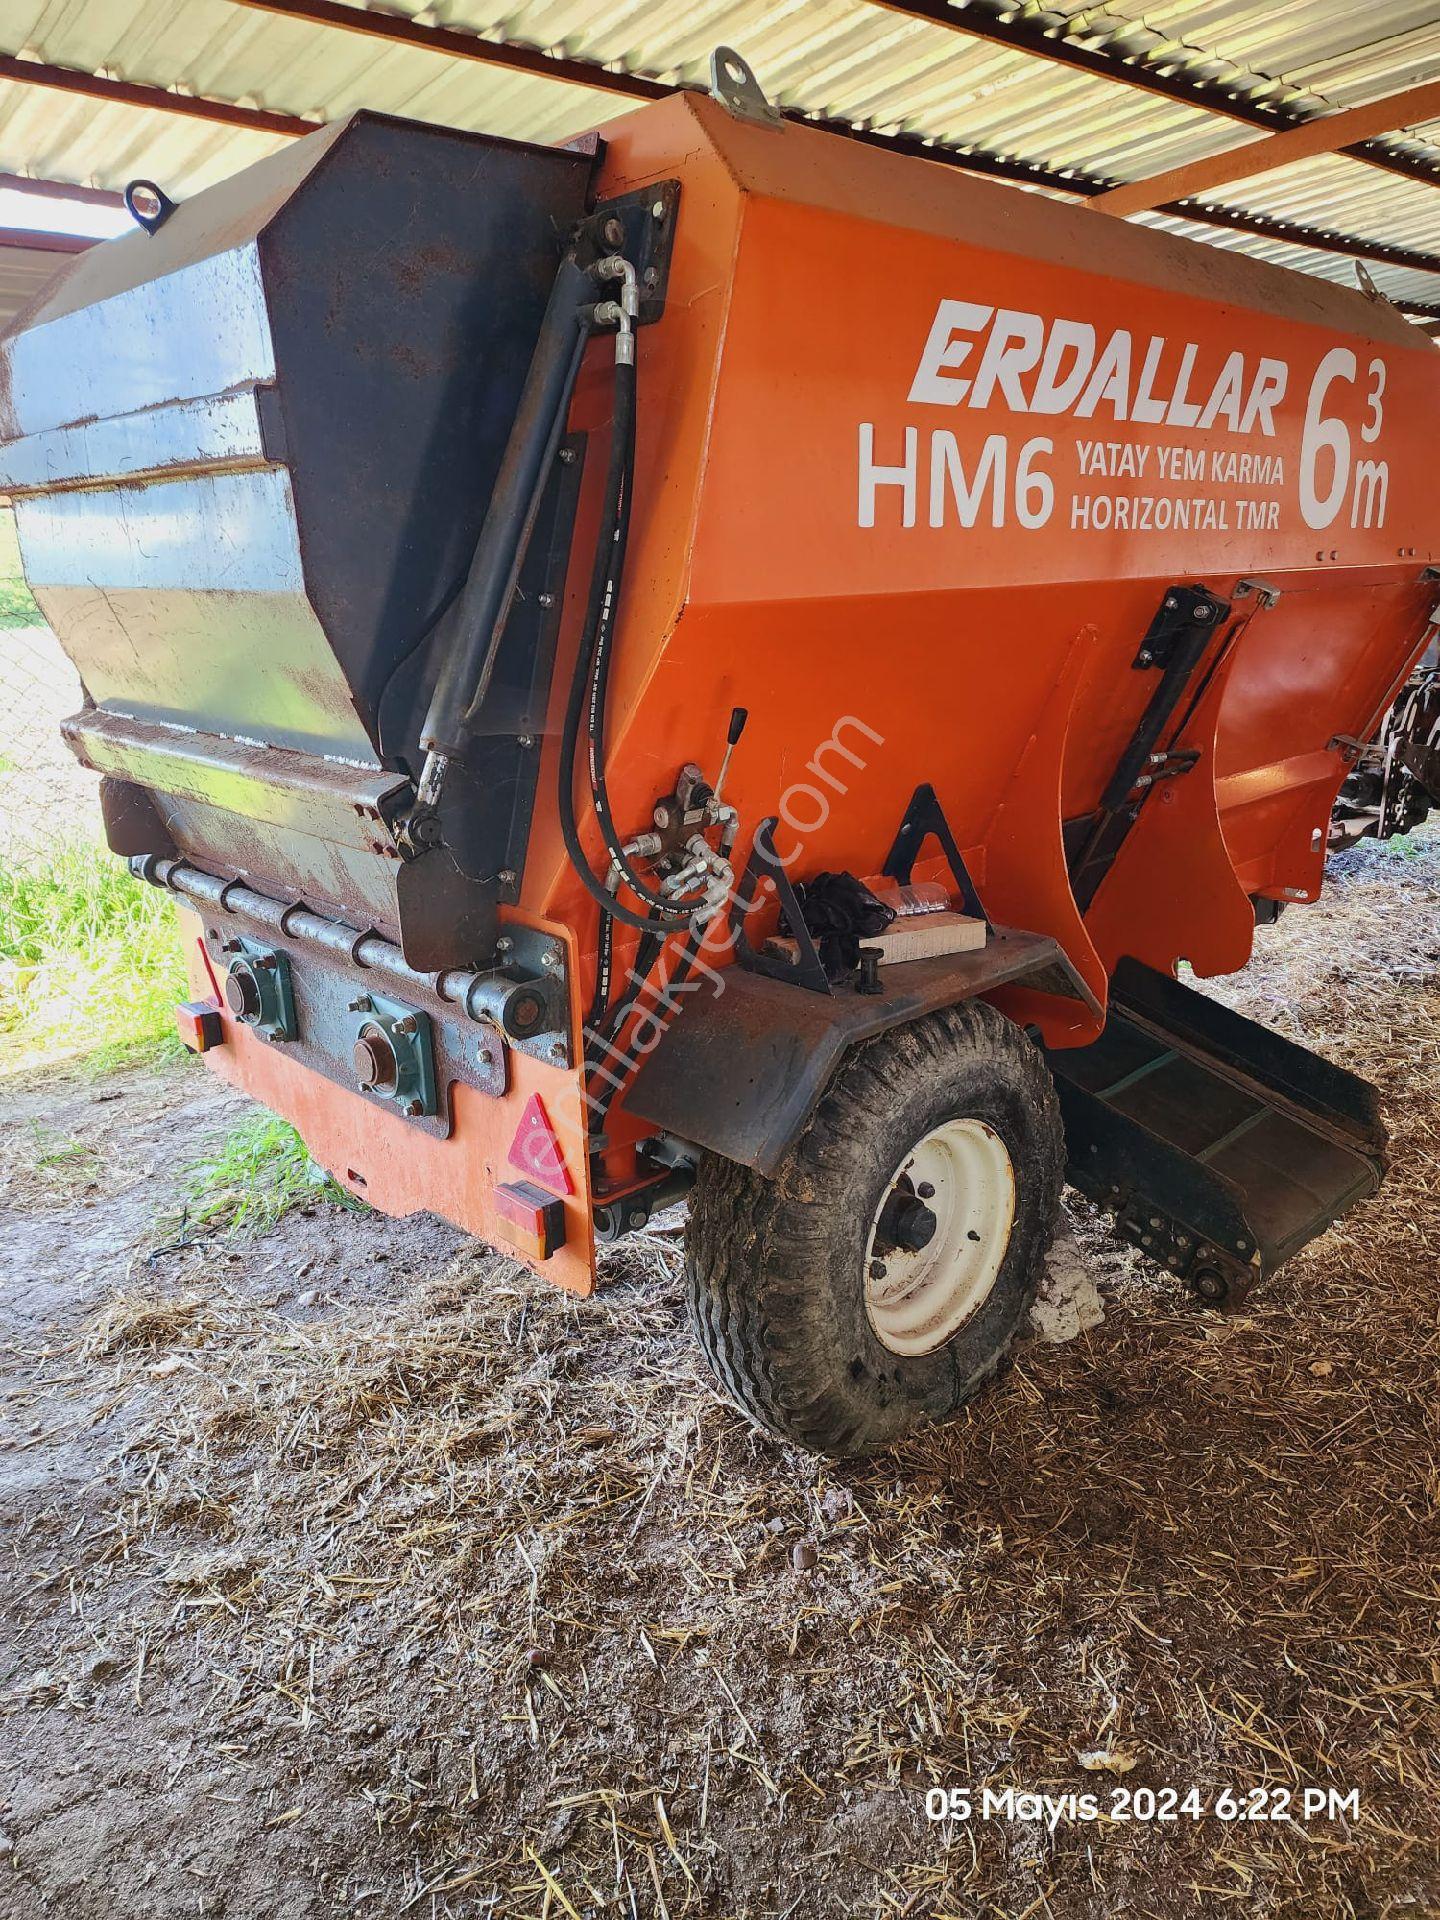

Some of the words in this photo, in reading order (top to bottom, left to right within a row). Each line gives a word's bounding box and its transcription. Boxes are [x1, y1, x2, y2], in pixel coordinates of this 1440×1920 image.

[906, 299, 1289, 437] ERDALLAR
[1360, 358, 1387, 443] 3
[857, 422, 1055, 530] HM6
[1075, 440, 1151, 478] YATAY
[1156, 446, 1206, 481] YEM
[1211, 451, 1284, 486] KARMA
[1298, 347, 1357, 530] 6
[1350, 459, 1389, 529] m
[1070, 495, 1229, 530] HORIZONTAL
[1235, 500, 1280, 530] TMR
